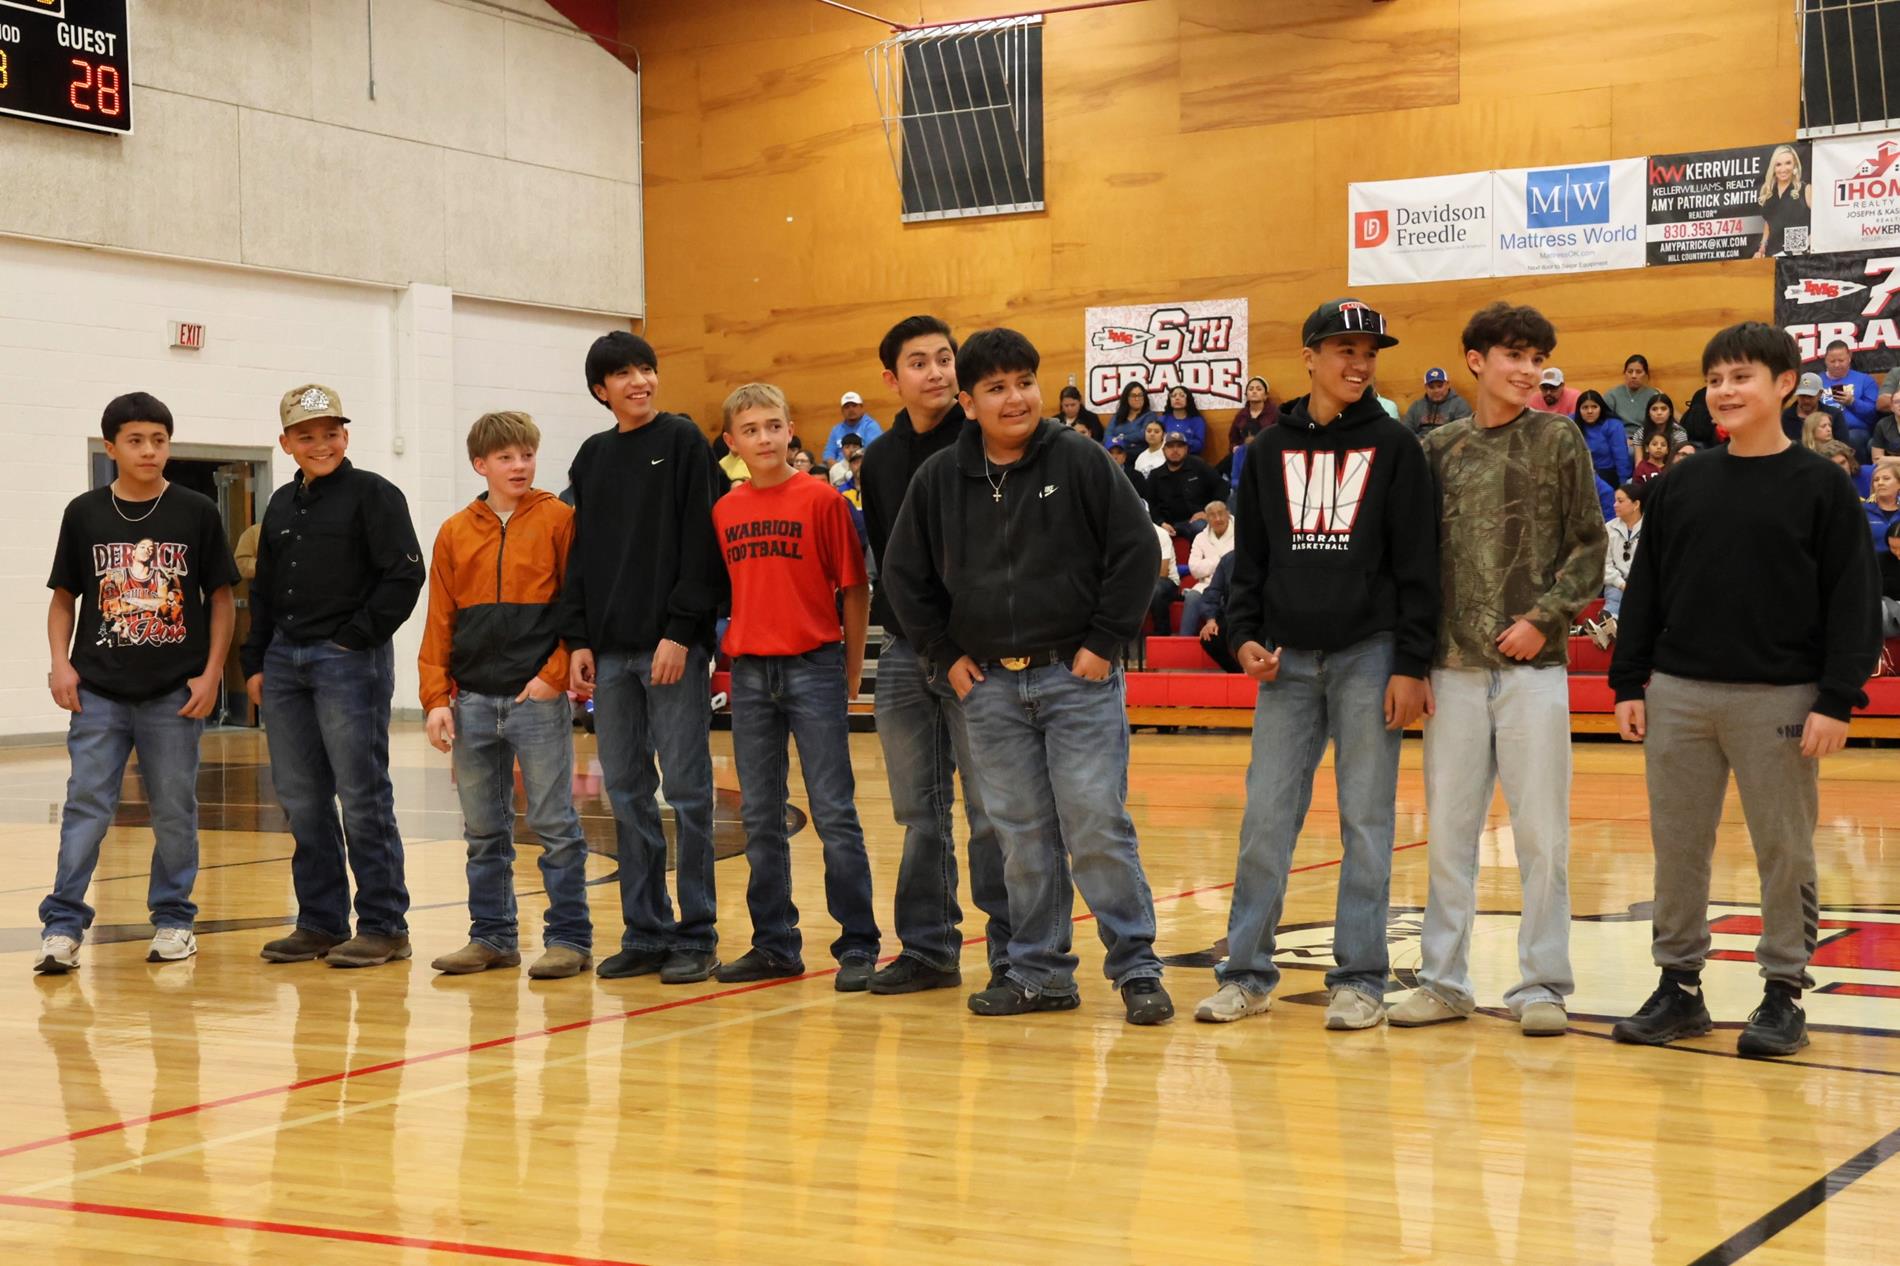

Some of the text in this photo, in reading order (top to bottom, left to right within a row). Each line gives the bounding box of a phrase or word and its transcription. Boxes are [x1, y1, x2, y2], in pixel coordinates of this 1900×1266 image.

[57, 22, 116, 56] GUEST
[70, 59, 120, 115] 28
[1686, 157, 1760, 180] KERRVILLE
[1726, 179, 1755, 190] REALTY
[1651, 190, 1758, 212] AMY PATRICK SMITH
[1853, 199, 1894, 209] REALTY
[1396, 204, 1486, 226] Davidson
[1847, 209, 1875, 219] JOSEPH
[1397, 224, 1467, 246] Freedle
[1500, 233, 1577, 250] Mattress
[1583, 224, 1637, 244] World
[1664, 219, 1743, 239] 830.353.7474
[1660, 236, 1747, 253] AMYPATRICK@KW.COM
[180, 323, 202, 346] EXIT
[1143, 308, 1233, 363] 6TH
[1090, 358, 1242, 406] GRADE
[725, 520, 803, 543] WARRIOR
[1292, 534, 1350, 543] INGRAM
[727, 540, 803, 565] FOOTBALL
[1292, 543, 1349, 551] BASKETBALL
[93, 543, 188, 576] DERICK
